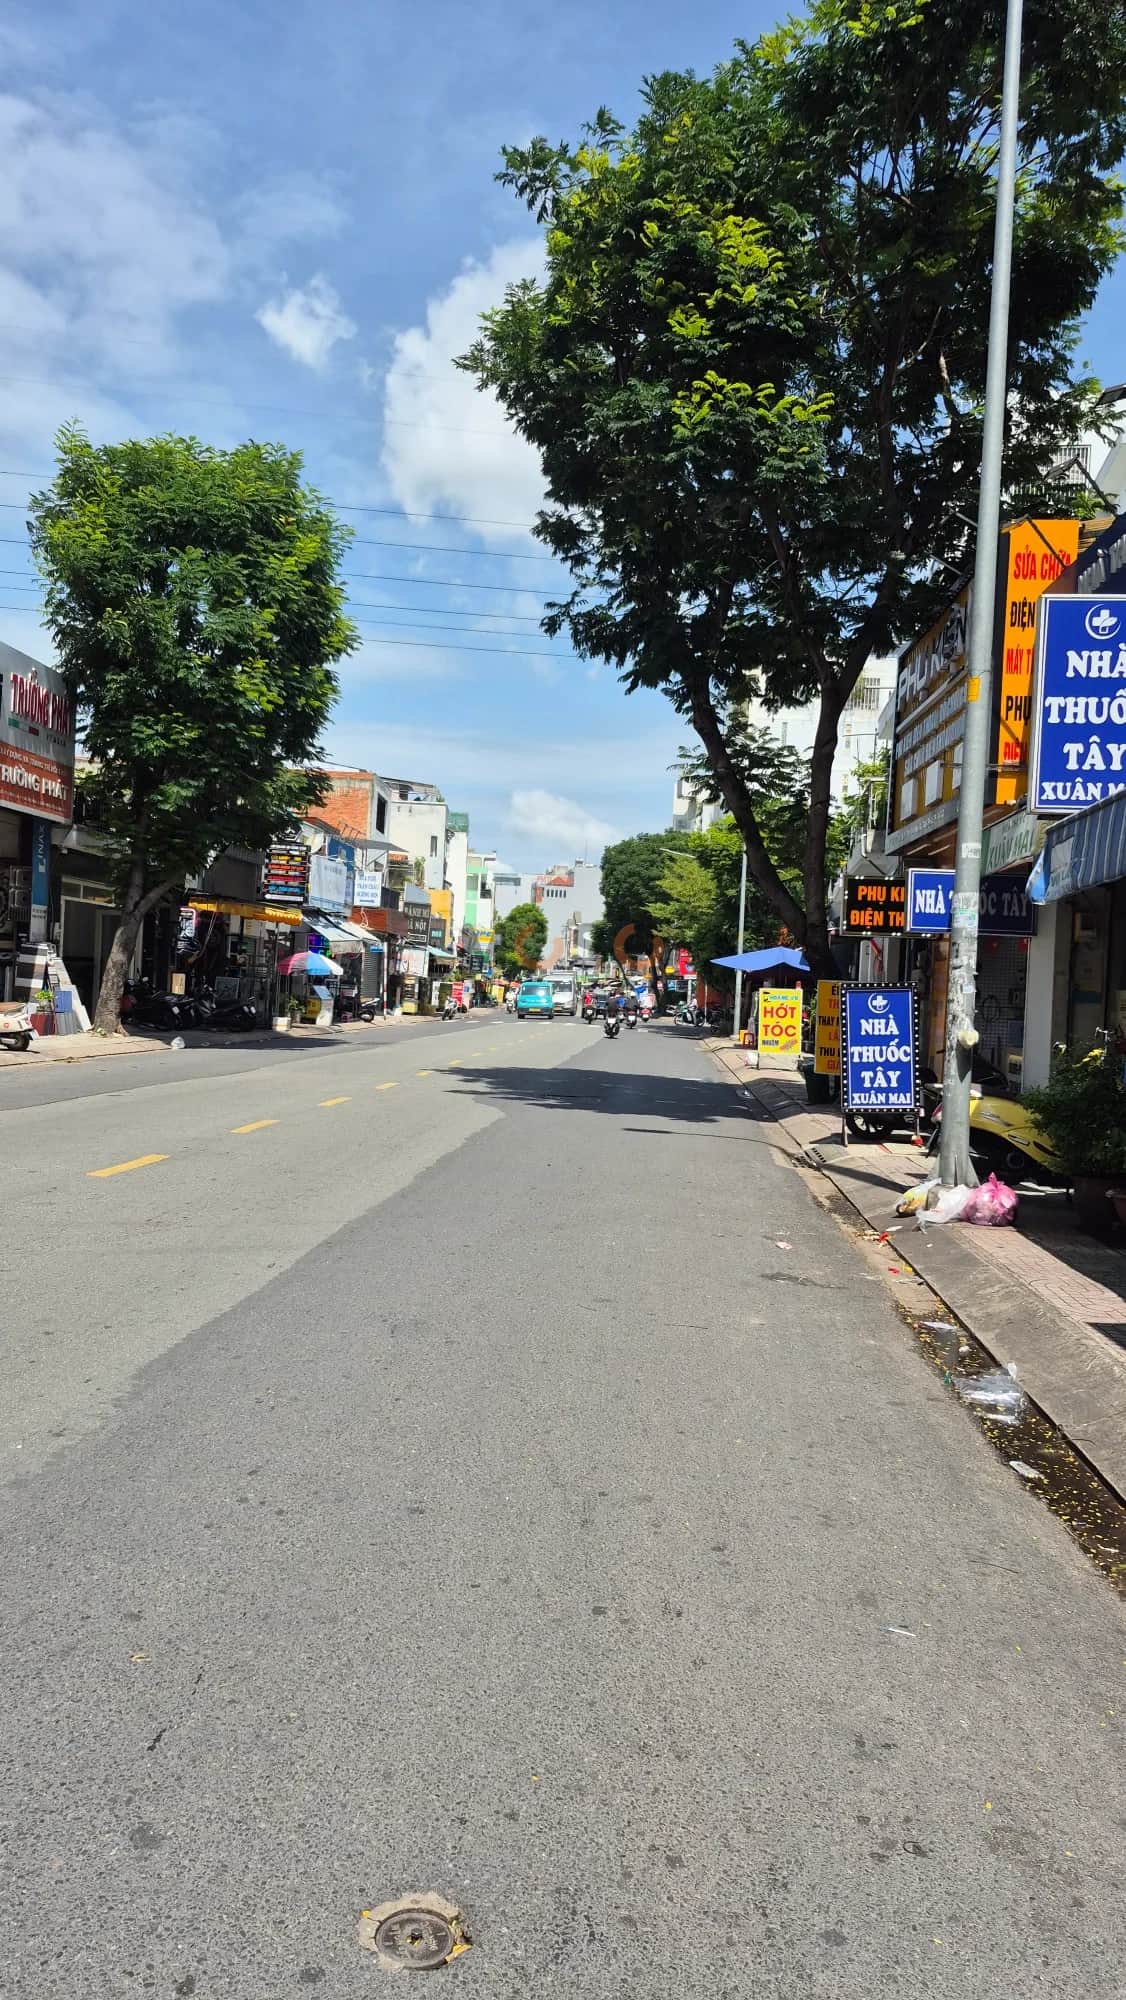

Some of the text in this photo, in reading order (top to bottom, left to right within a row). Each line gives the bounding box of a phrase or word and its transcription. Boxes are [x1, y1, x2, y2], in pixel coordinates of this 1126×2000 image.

[1014, 544, 1036, 581] SỬA
[1007, 643, 1024, 675] MÁY
[1045, 688, 1126, 725] THUỐ
[1063, 736, 1126, 771] TÂY
[42, 778, 69, 801] PHÁT
[1041, 777, 1101, 801] XUÂN
[858, 886, 887, 905] PHỤ
[915, 885, 945, 914] NHÀ
[1002, 886, 1028, 917] TÂY
[850, 908, 884, 928] ĐIỆN
[763, 1003, 796, 1018] HỚT
[763, 1021, 797, 1037] TÓC
[860, 1014, 899, 1035] NHÀ
[850, 1038, 911, 1063] THUỐC
[861, 1066, 902, 1088] TÂY
[852, 1090, 912, 1105] XUÂN MAI
